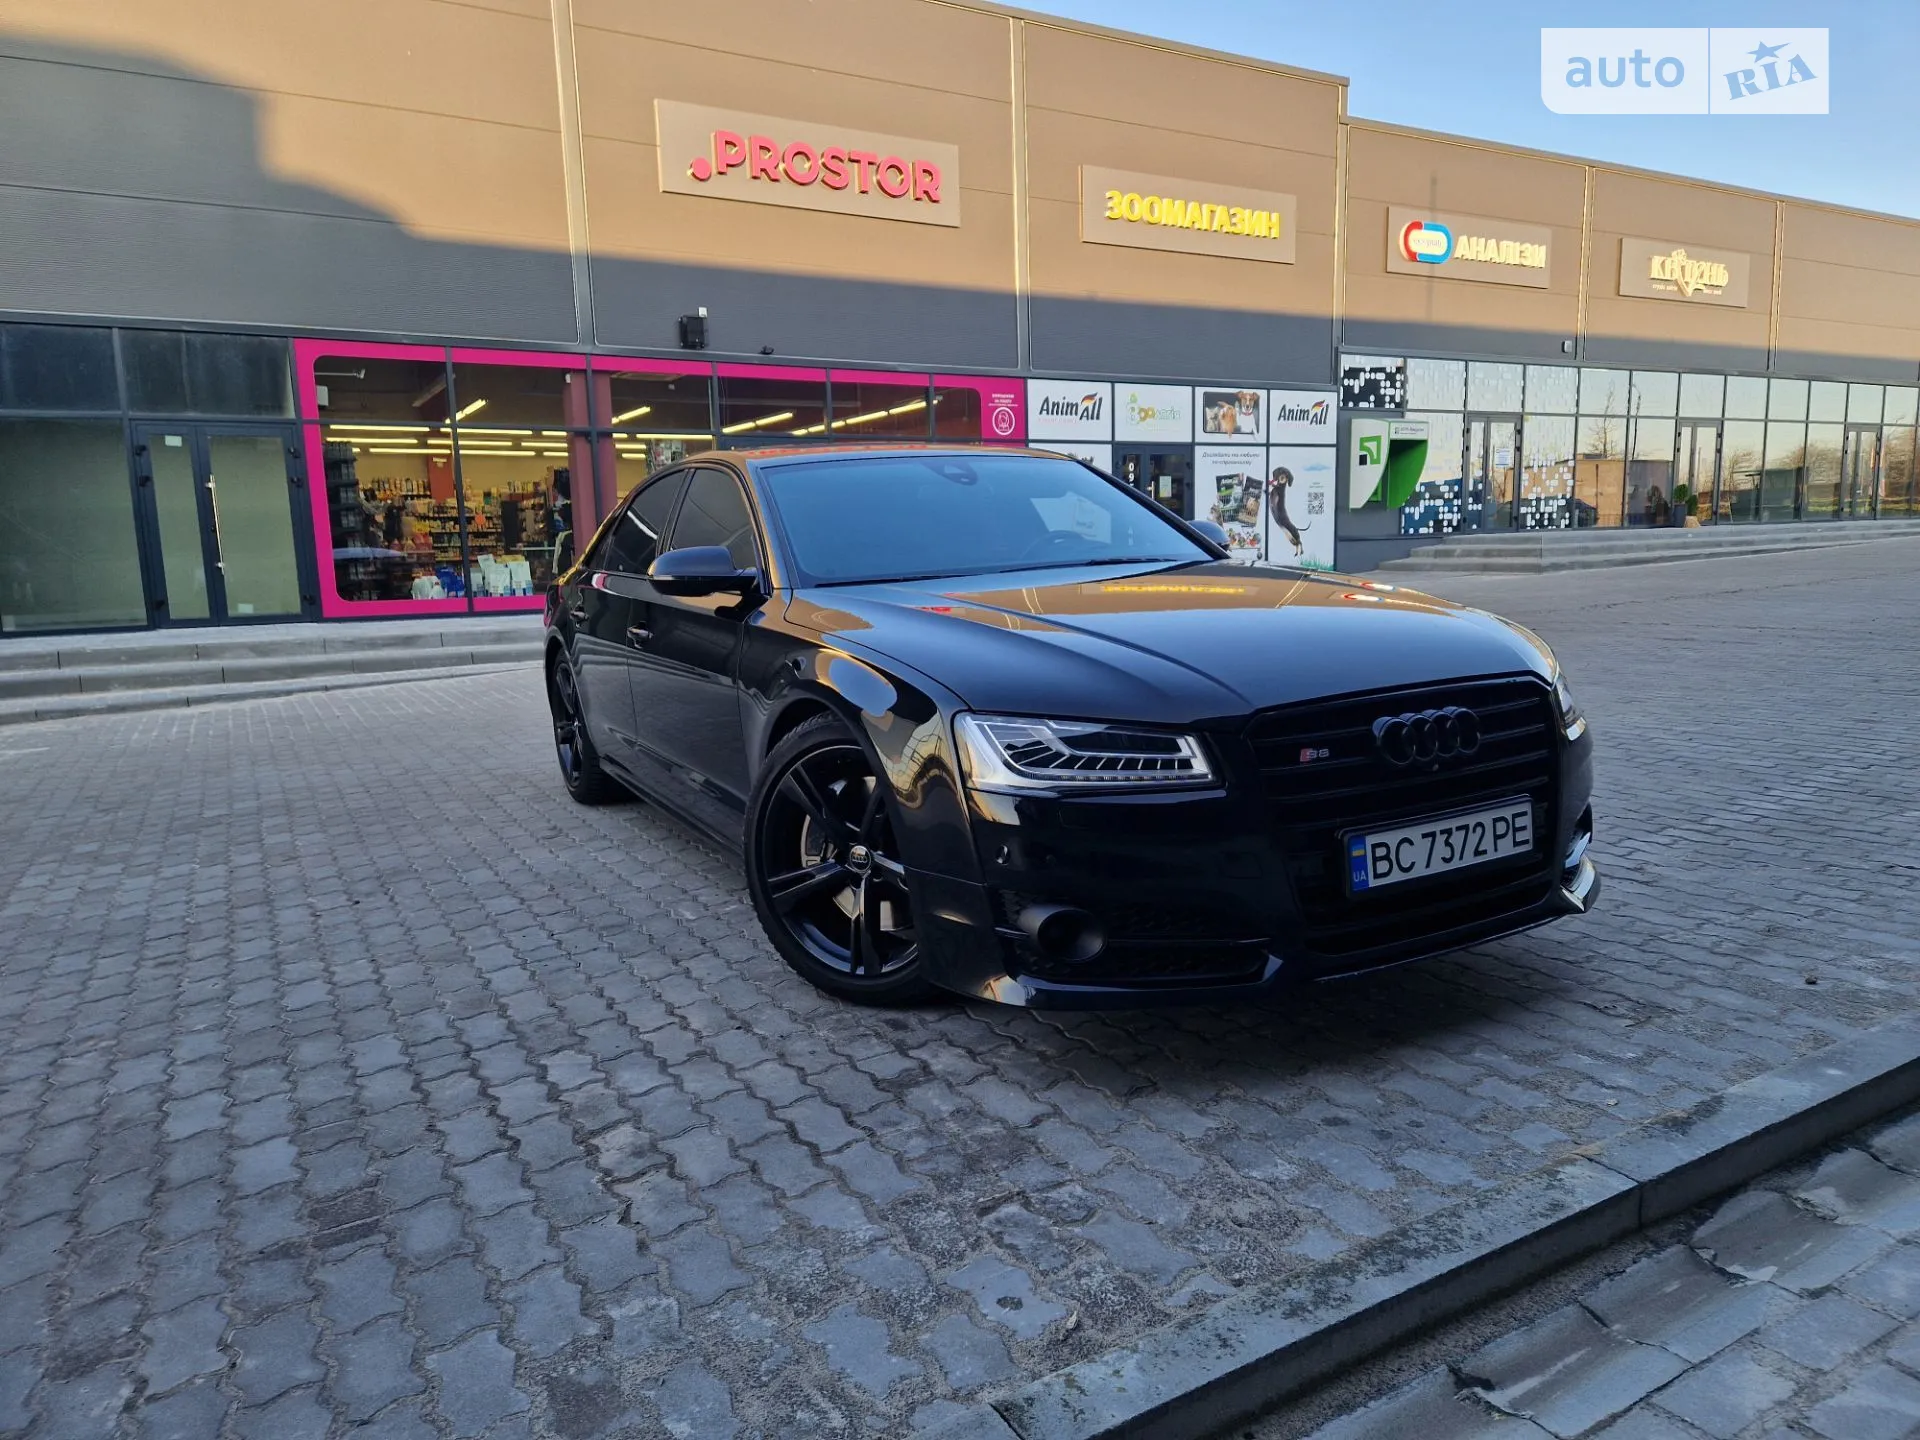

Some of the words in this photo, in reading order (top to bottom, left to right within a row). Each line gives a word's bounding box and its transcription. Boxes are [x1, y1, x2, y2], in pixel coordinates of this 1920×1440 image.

[1105, 189, 1280, 239] ЗООМАГАЗИН
[1370, 836, 1416, 880] BC
[1420, 820, 1488, 870] 7372
[1491, 809, 1531, 853] PE
[1352, 870, 1367, 882] UA
